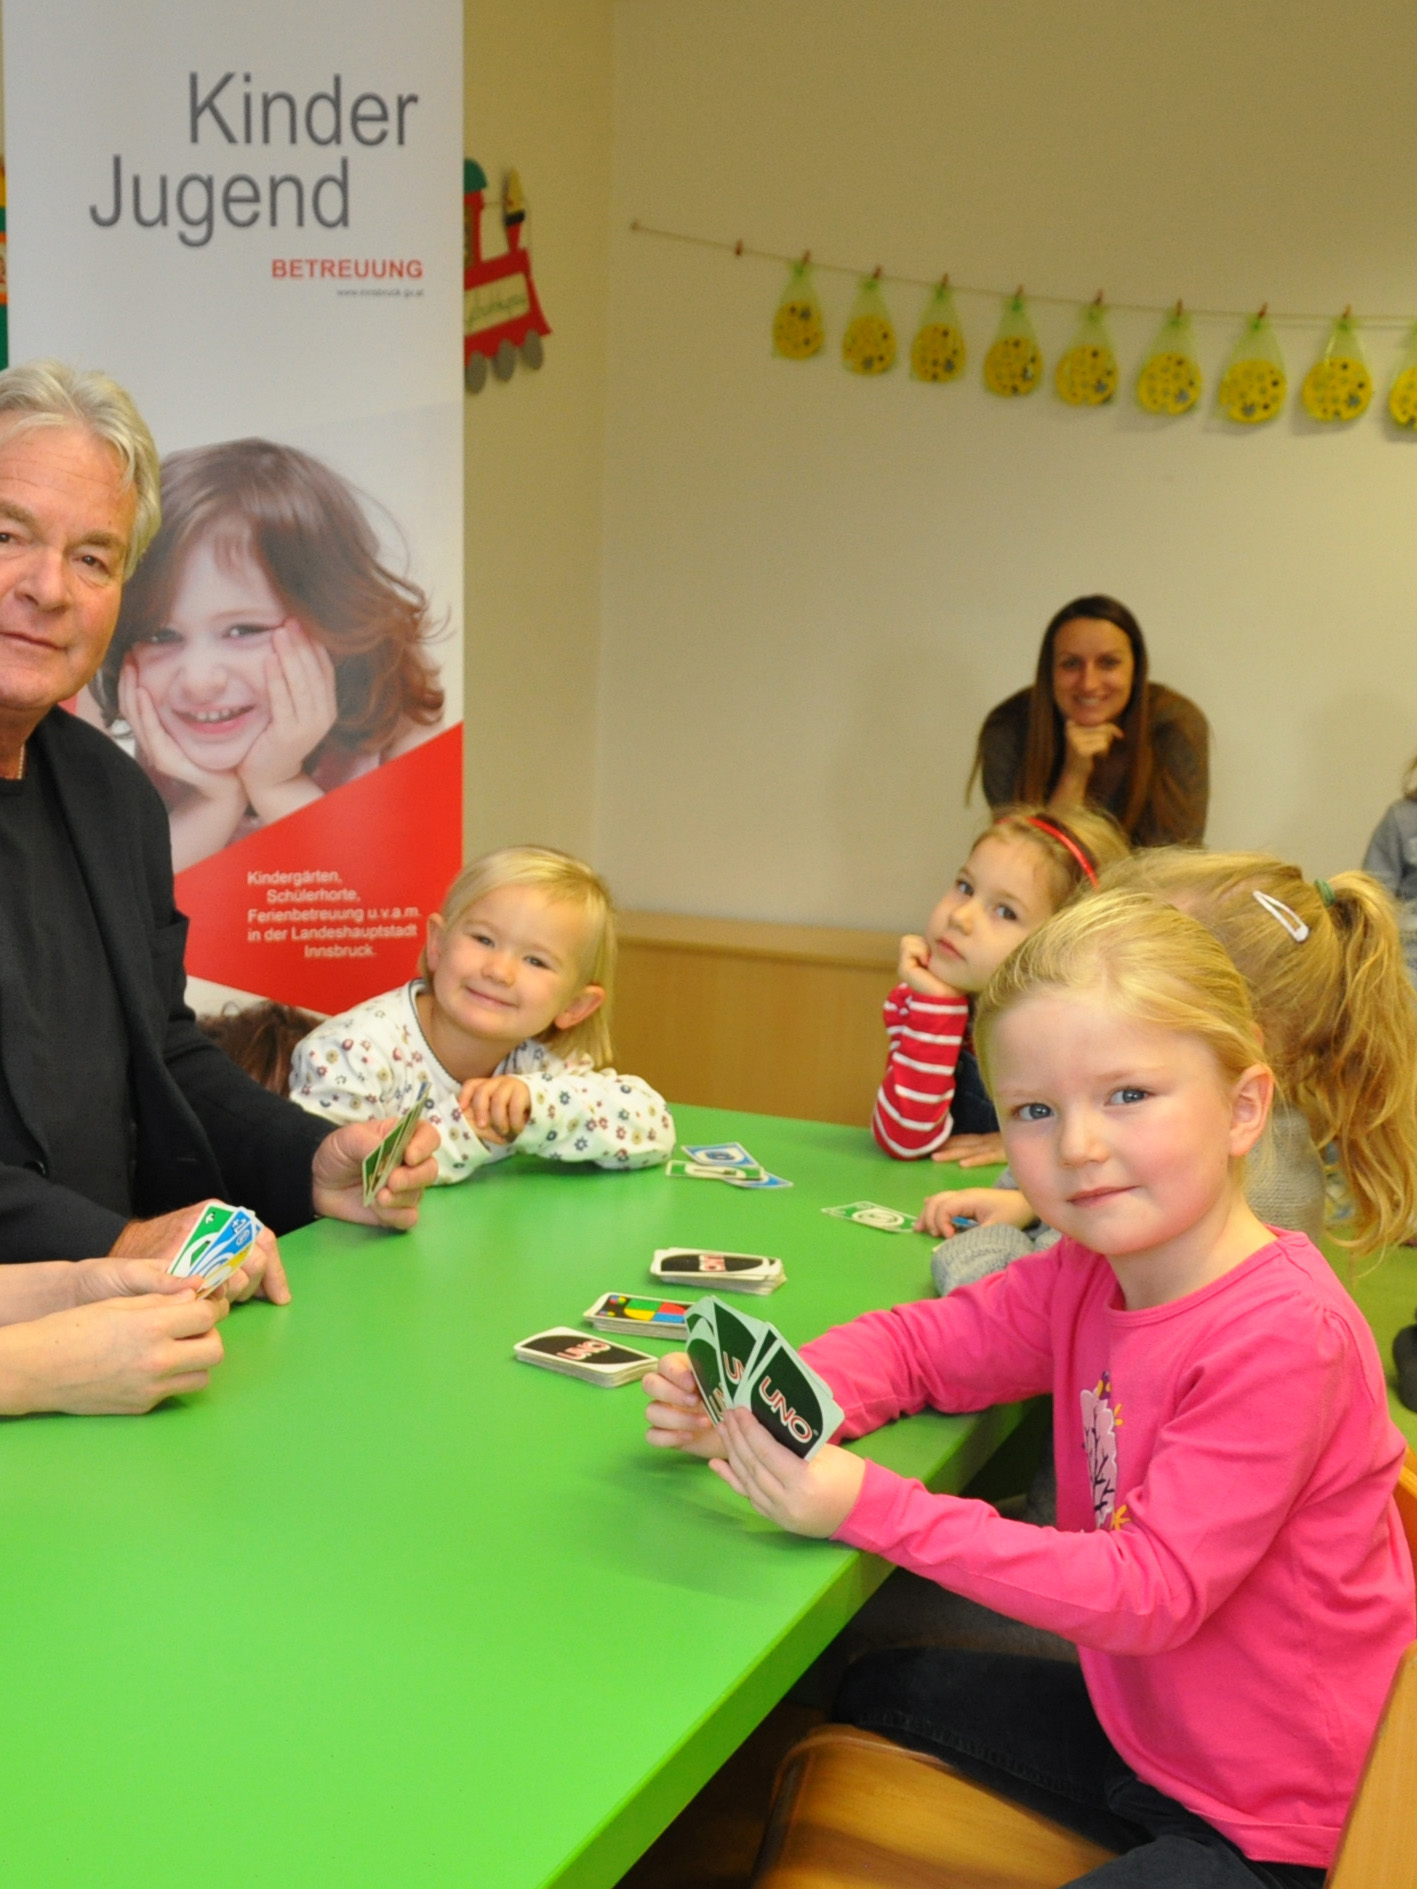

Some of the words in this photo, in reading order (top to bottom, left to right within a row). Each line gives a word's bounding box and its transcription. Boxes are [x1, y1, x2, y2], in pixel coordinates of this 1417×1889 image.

[188, 72, 419, 146] Kinder
[88, 154, 350, 247] Jugend
[271, 259, 424, 279] BETREUUNG
[247, 870, 342, 886] Kindergärten,
[266, 888, 361, 904] Schülerhorte,
[247, 907, 364, 923] Ferienbetreuung
[247, 929, 261, 942] in
[264, 928, 288, 942] der
[290, 924, 417, 940] Landeshauptstadt
[556, 1340, 611, 1361] UNO
[758, 1375, 813, 1443] UNO
